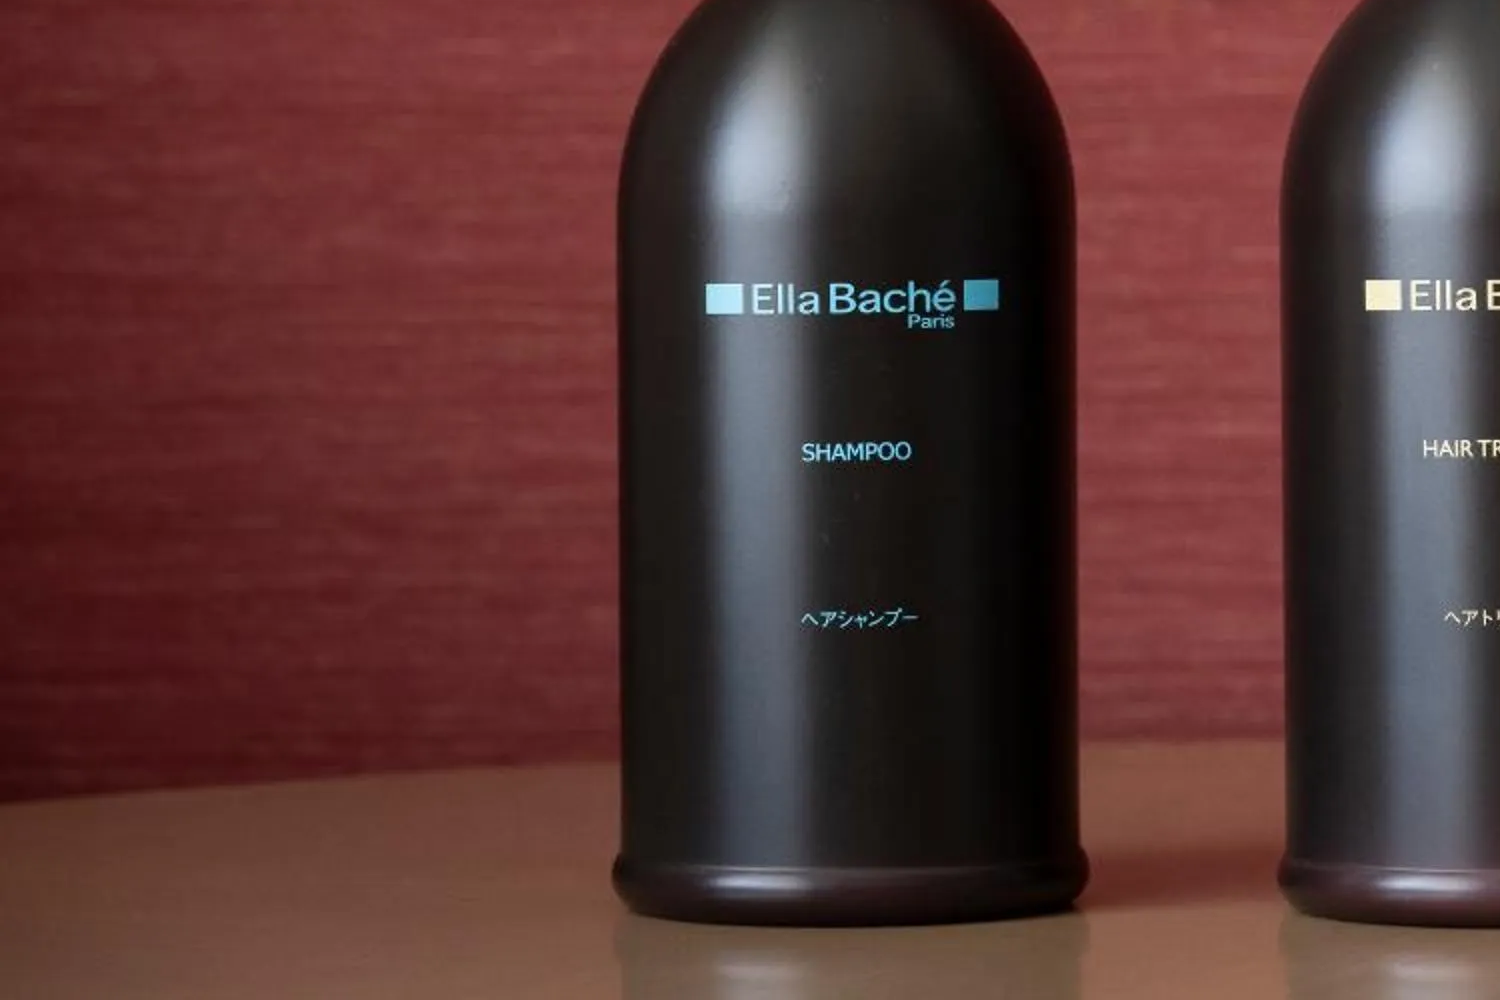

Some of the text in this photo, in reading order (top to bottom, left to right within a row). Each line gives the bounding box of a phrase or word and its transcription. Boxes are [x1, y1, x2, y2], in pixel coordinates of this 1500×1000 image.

[751, 279, 957, 316] Ella Baché
[1409, 279, 1479, 312] Ella
[906, 313, 956, 330] Paris
[801, 440, 914, 463] SHAMPOO
[1423, 438, 1475, 459] HAIR
[801, 607, 920, 630] ヘアシャンプー
